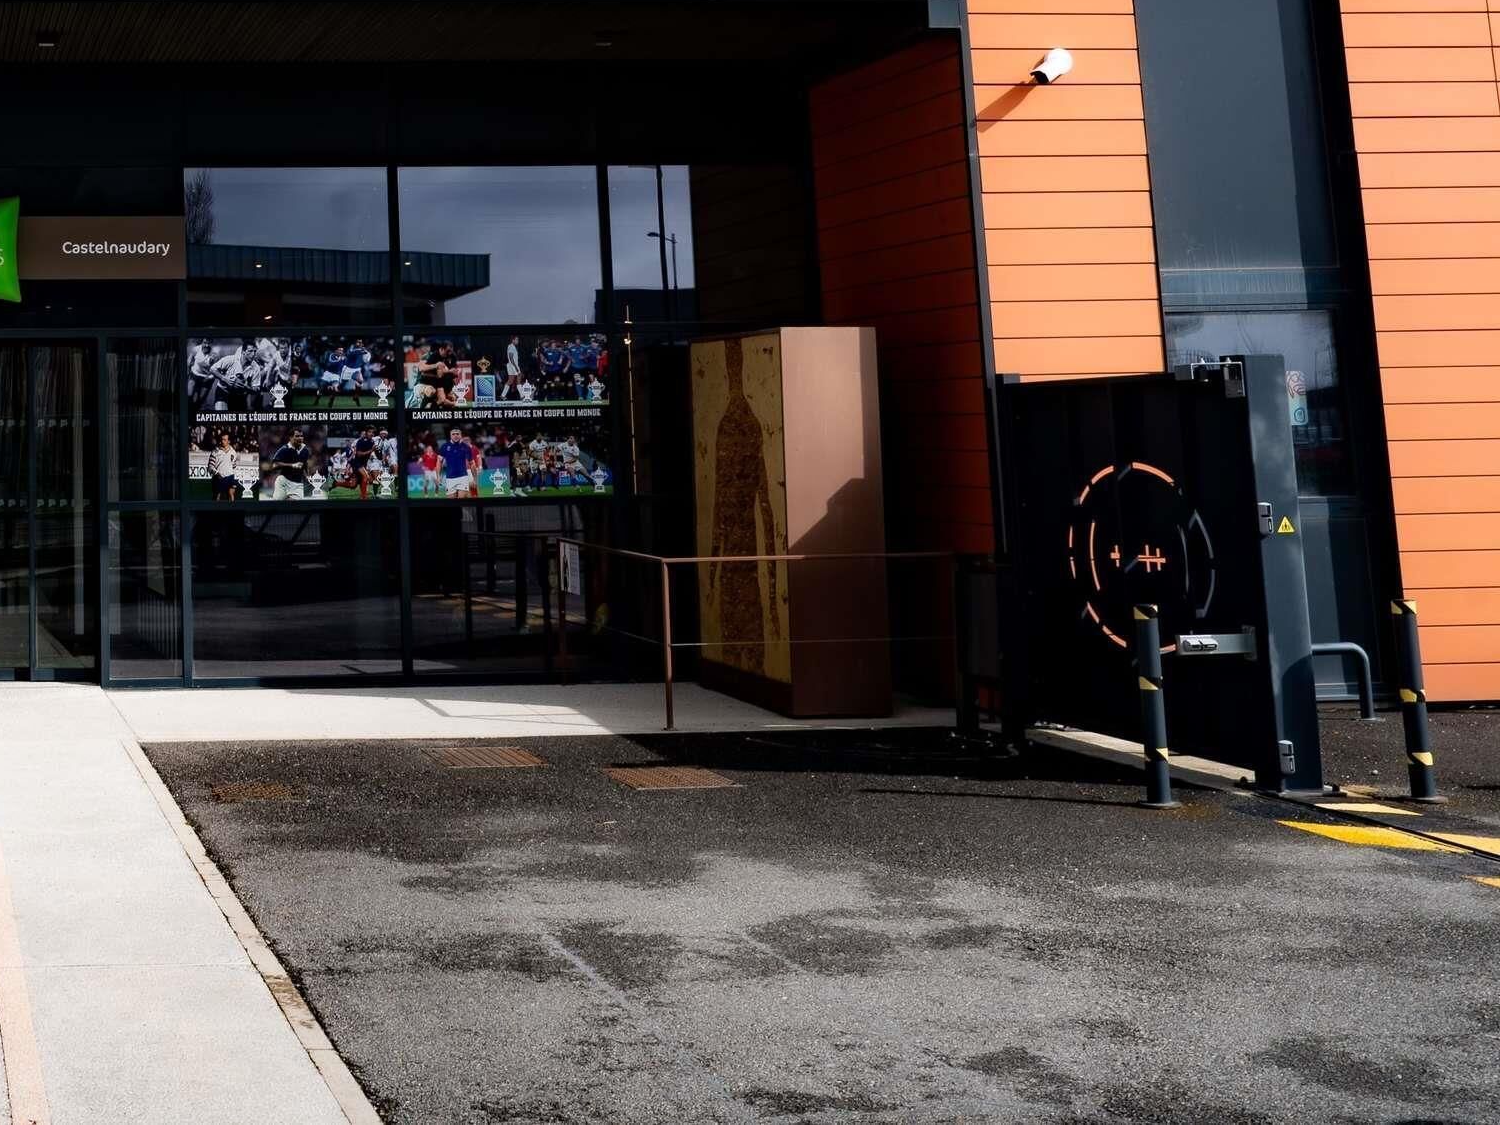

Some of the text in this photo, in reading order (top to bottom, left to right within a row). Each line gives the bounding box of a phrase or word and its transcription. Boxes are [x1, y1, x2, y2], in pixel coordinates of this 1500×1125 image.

[62, 241, 170, 257] Castelnaudary
[196, 411, 388, 422] CAPITAINES DE L'ÉQUIPE DE FRANCE EN COUPE DU MONDE
[412, 408, 601, 420] CAPITAINES DE L'ÉQUIPE DE FRANCE EN COUPE DU MONDE
